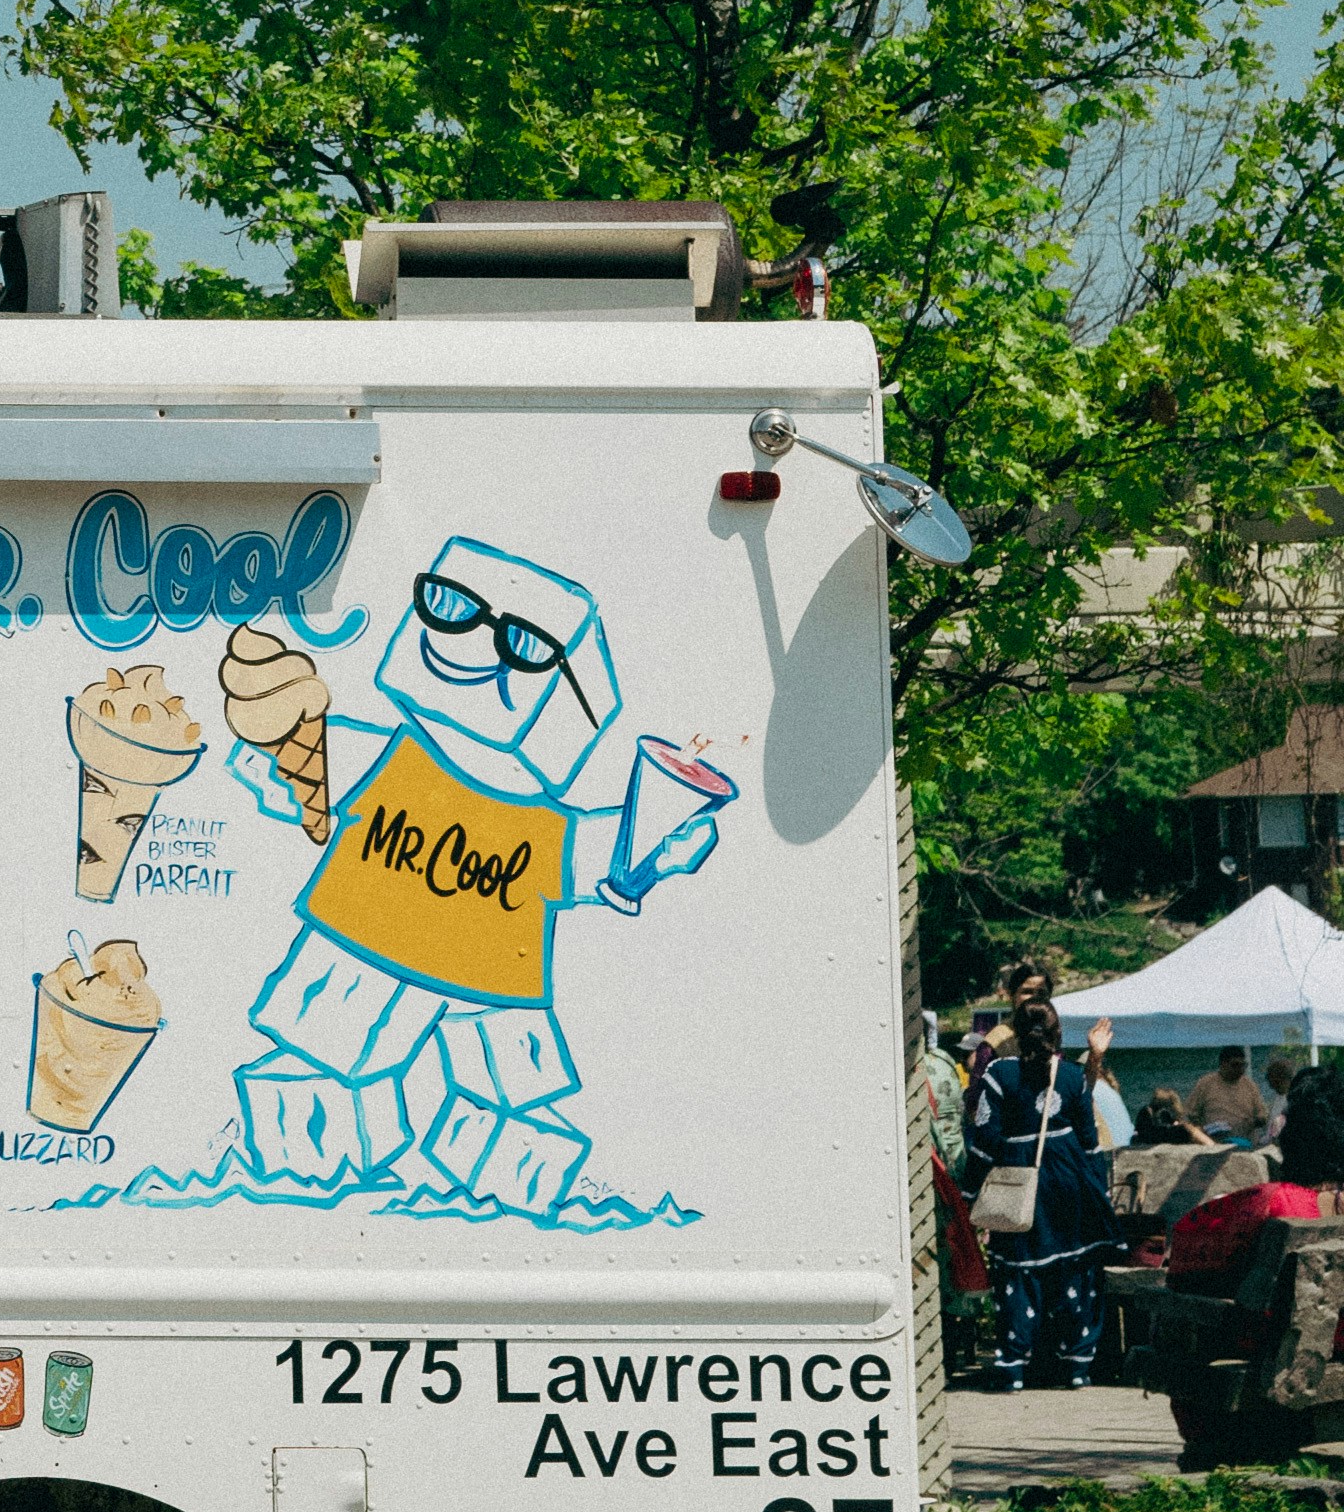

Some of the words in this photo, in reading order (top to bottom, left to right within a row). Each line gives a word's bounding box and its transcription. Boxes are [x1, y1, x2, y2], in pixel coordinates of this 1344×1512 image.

[65, 489, 371, 653] Cool
[148, 840, 216, 860] BUSTER
[152, 814, 227, 838] PEANUT
[136, 863, 238, 897] PARFAIT
[426, 822, 532, 912] Cool
[275, 1340, 463, 1405] 1275
[495, 1339, 892, 1404] Lawrence
[524, 1413, 678, 1478] Ave
[712, 1411, 891, 1478] East
